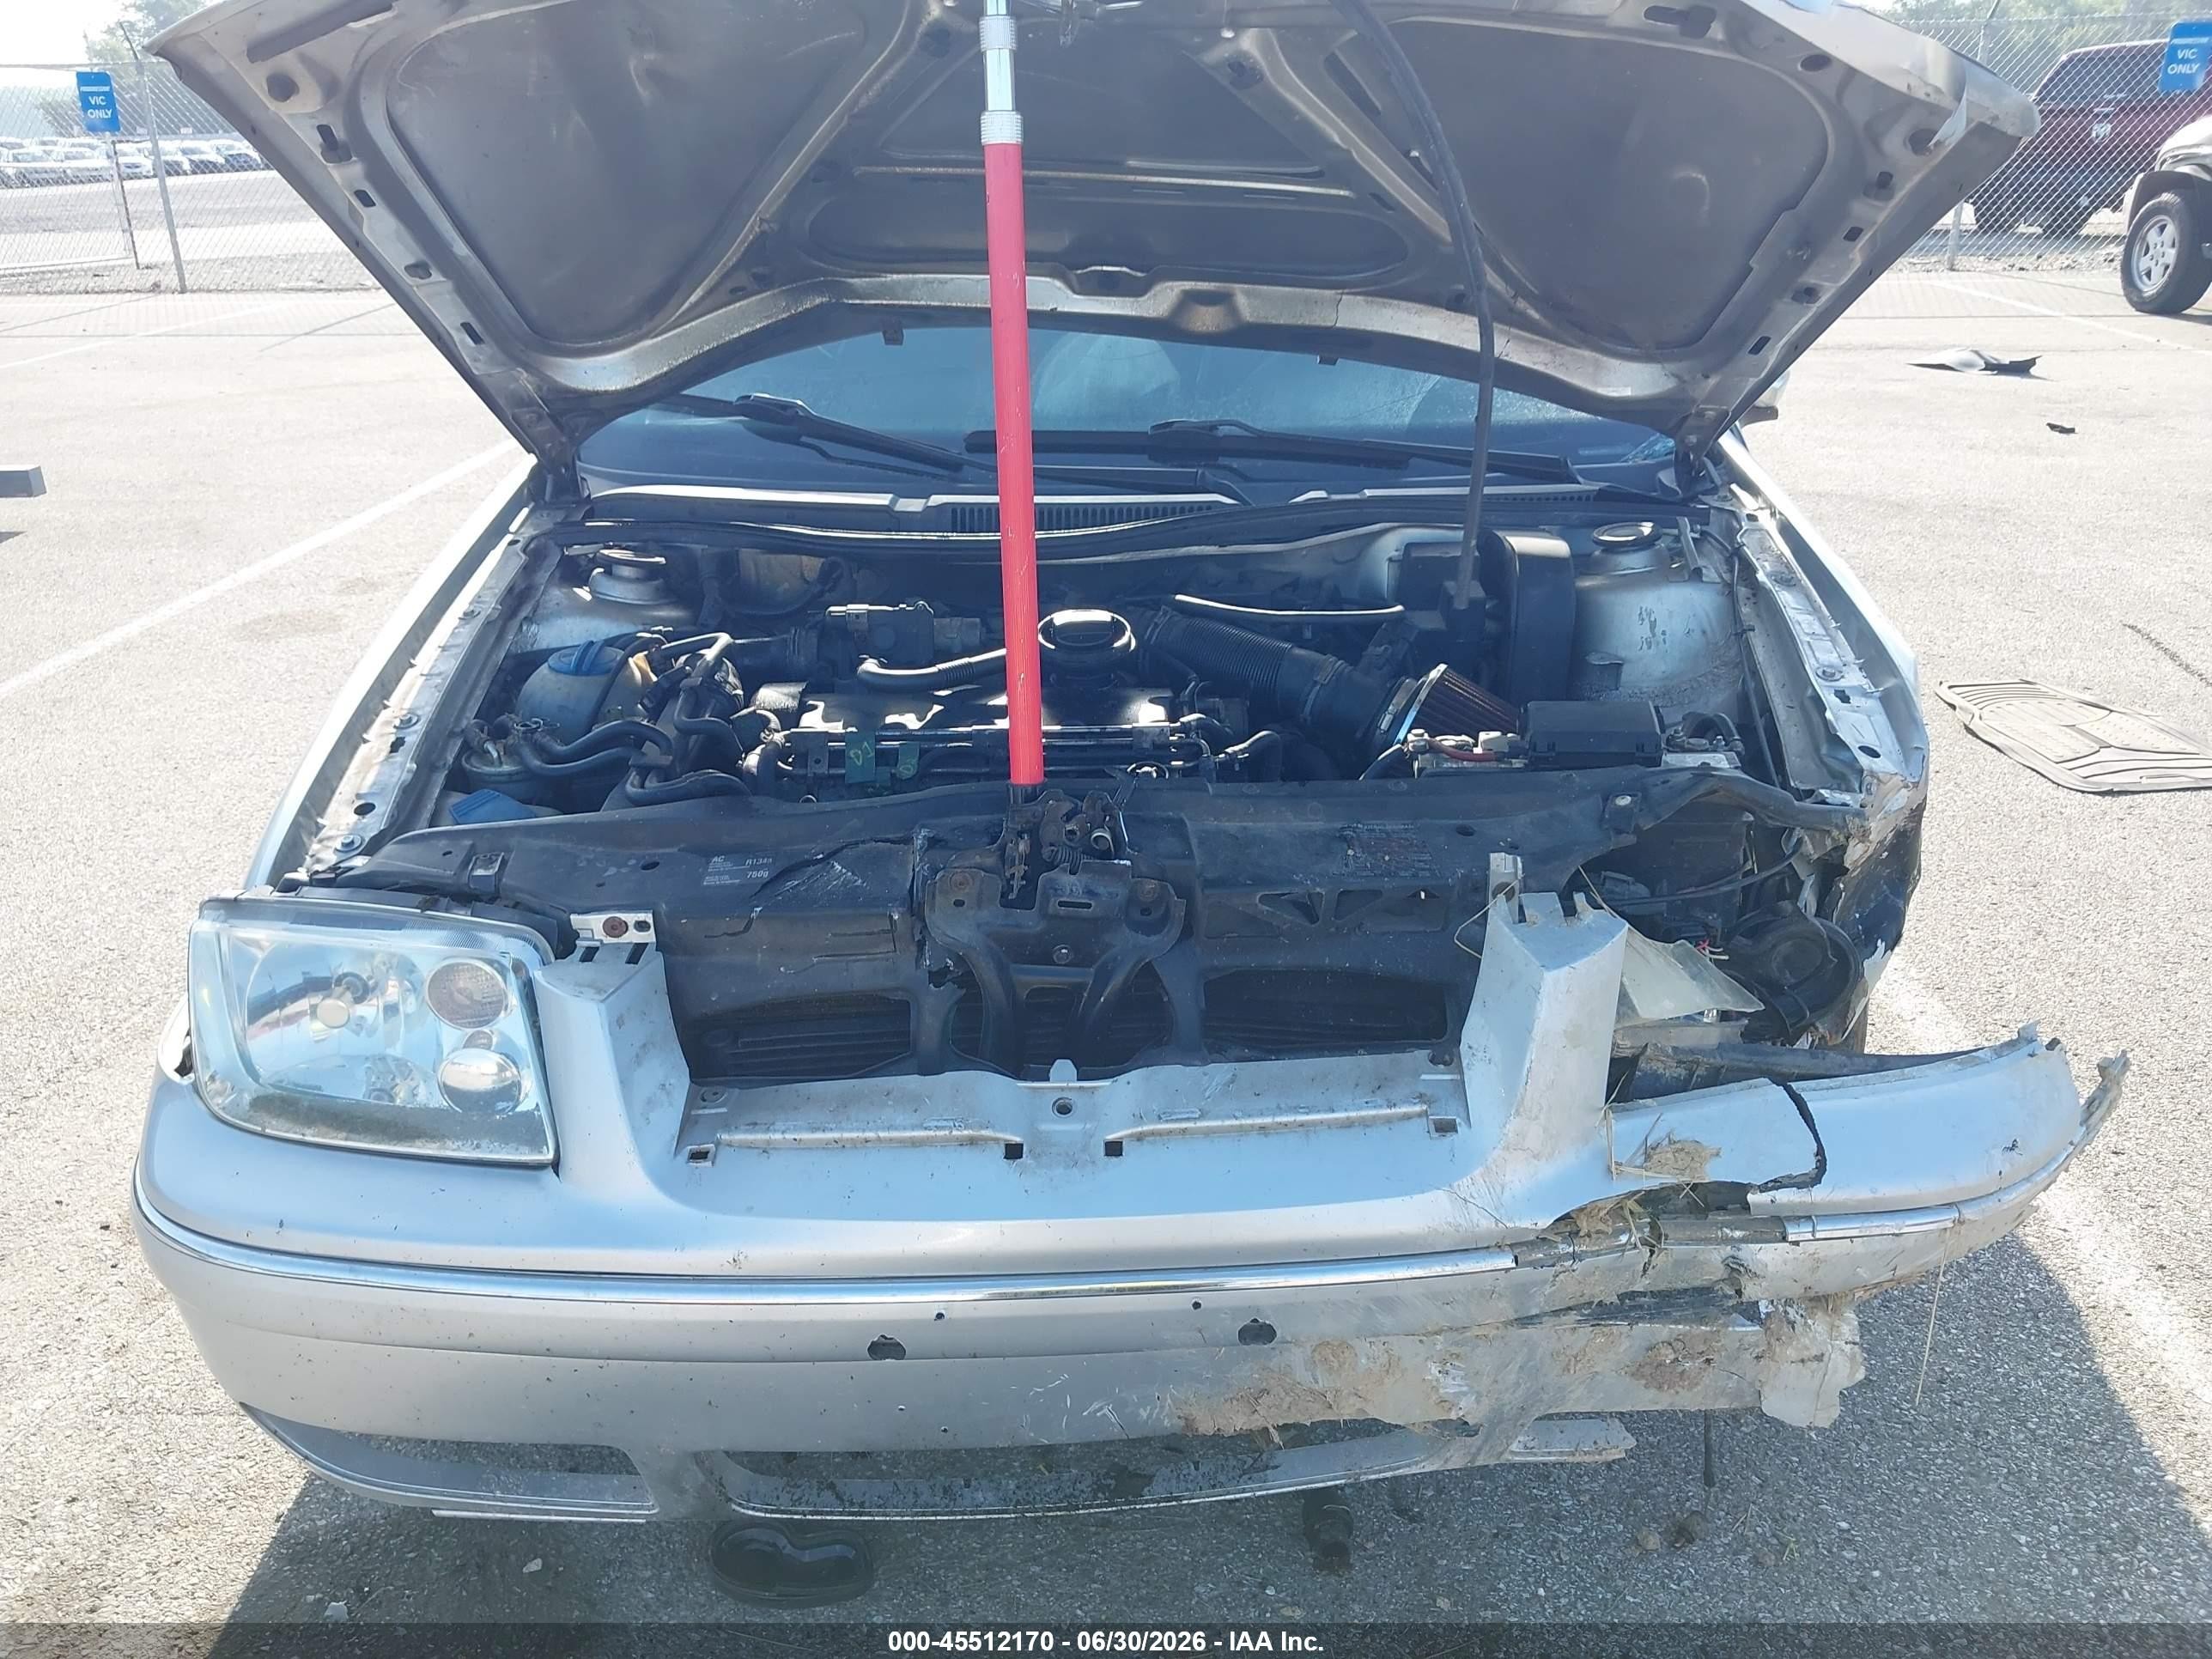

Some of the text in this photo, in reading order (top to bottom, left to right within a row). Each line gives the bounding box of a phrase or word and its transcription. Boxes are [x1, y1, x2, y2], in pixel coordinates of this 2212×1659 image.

[2177, 48, 2198, 59] VIC
[2167, 64, 2200, 75] ONLY
[88, 96, 107, 106] VIC
[88, 109, 112, 118] ONLY
